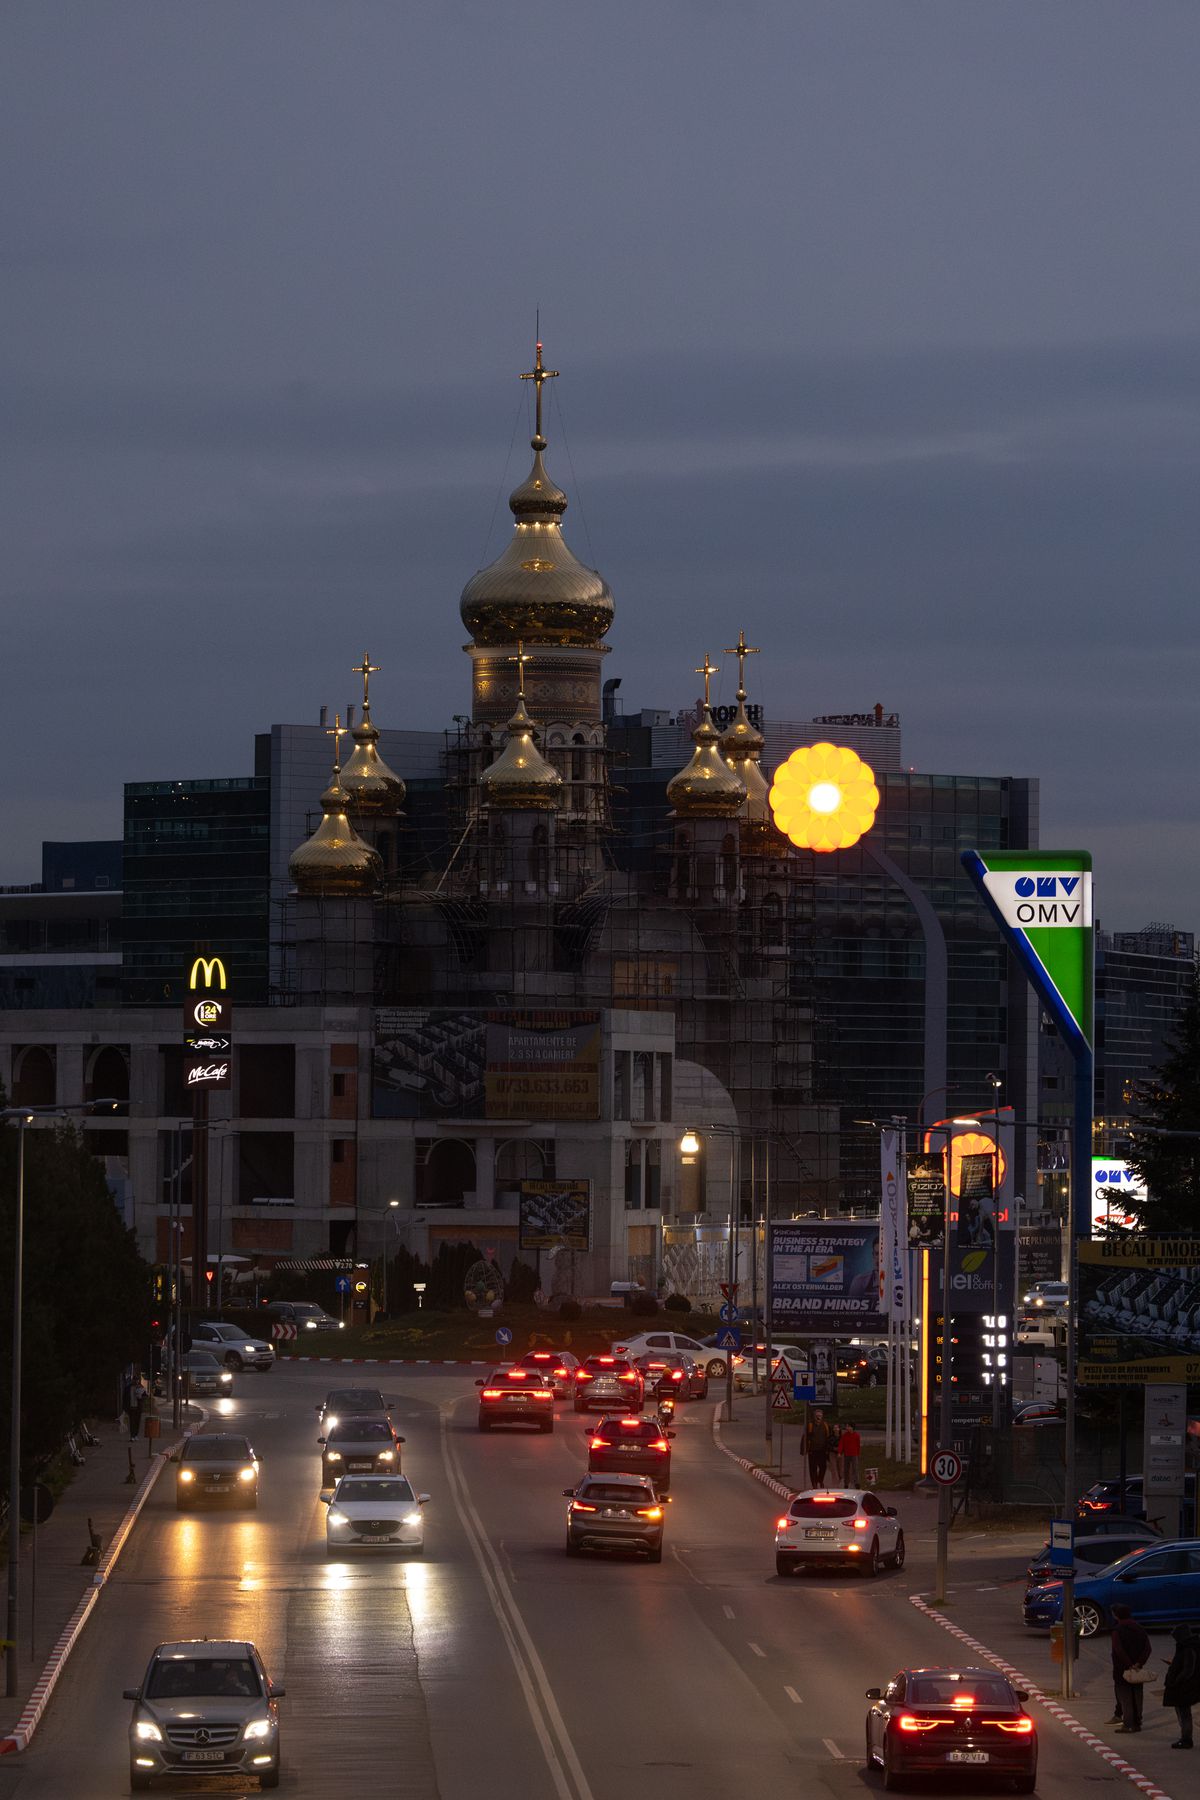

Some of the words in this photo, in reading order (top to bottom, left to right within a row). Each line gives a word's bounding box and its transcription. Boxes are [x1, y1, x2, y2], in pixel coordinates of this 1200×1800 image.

[1016, 904, 1080, 922] OMV
[773, 1237, 818, 1246] BUSINESS
[818, 1238, 866, 1247] STRATEGY
[773, 1245, 783, 1253] IN
[785, 1245, 804, 1253] THE
[815, 1246, 834, 1254] ERA
[1102, 1242, 1155, 1257] BECALI
[792, 1283, 844, 1291] OSTERWALDER
[772, 1298, 823, 1310] BRAND
[824, 1299, 870, 1311] MINDS
[939, 1458, 954, 1477] 30
[960, 1753, 970, 1761] 92
